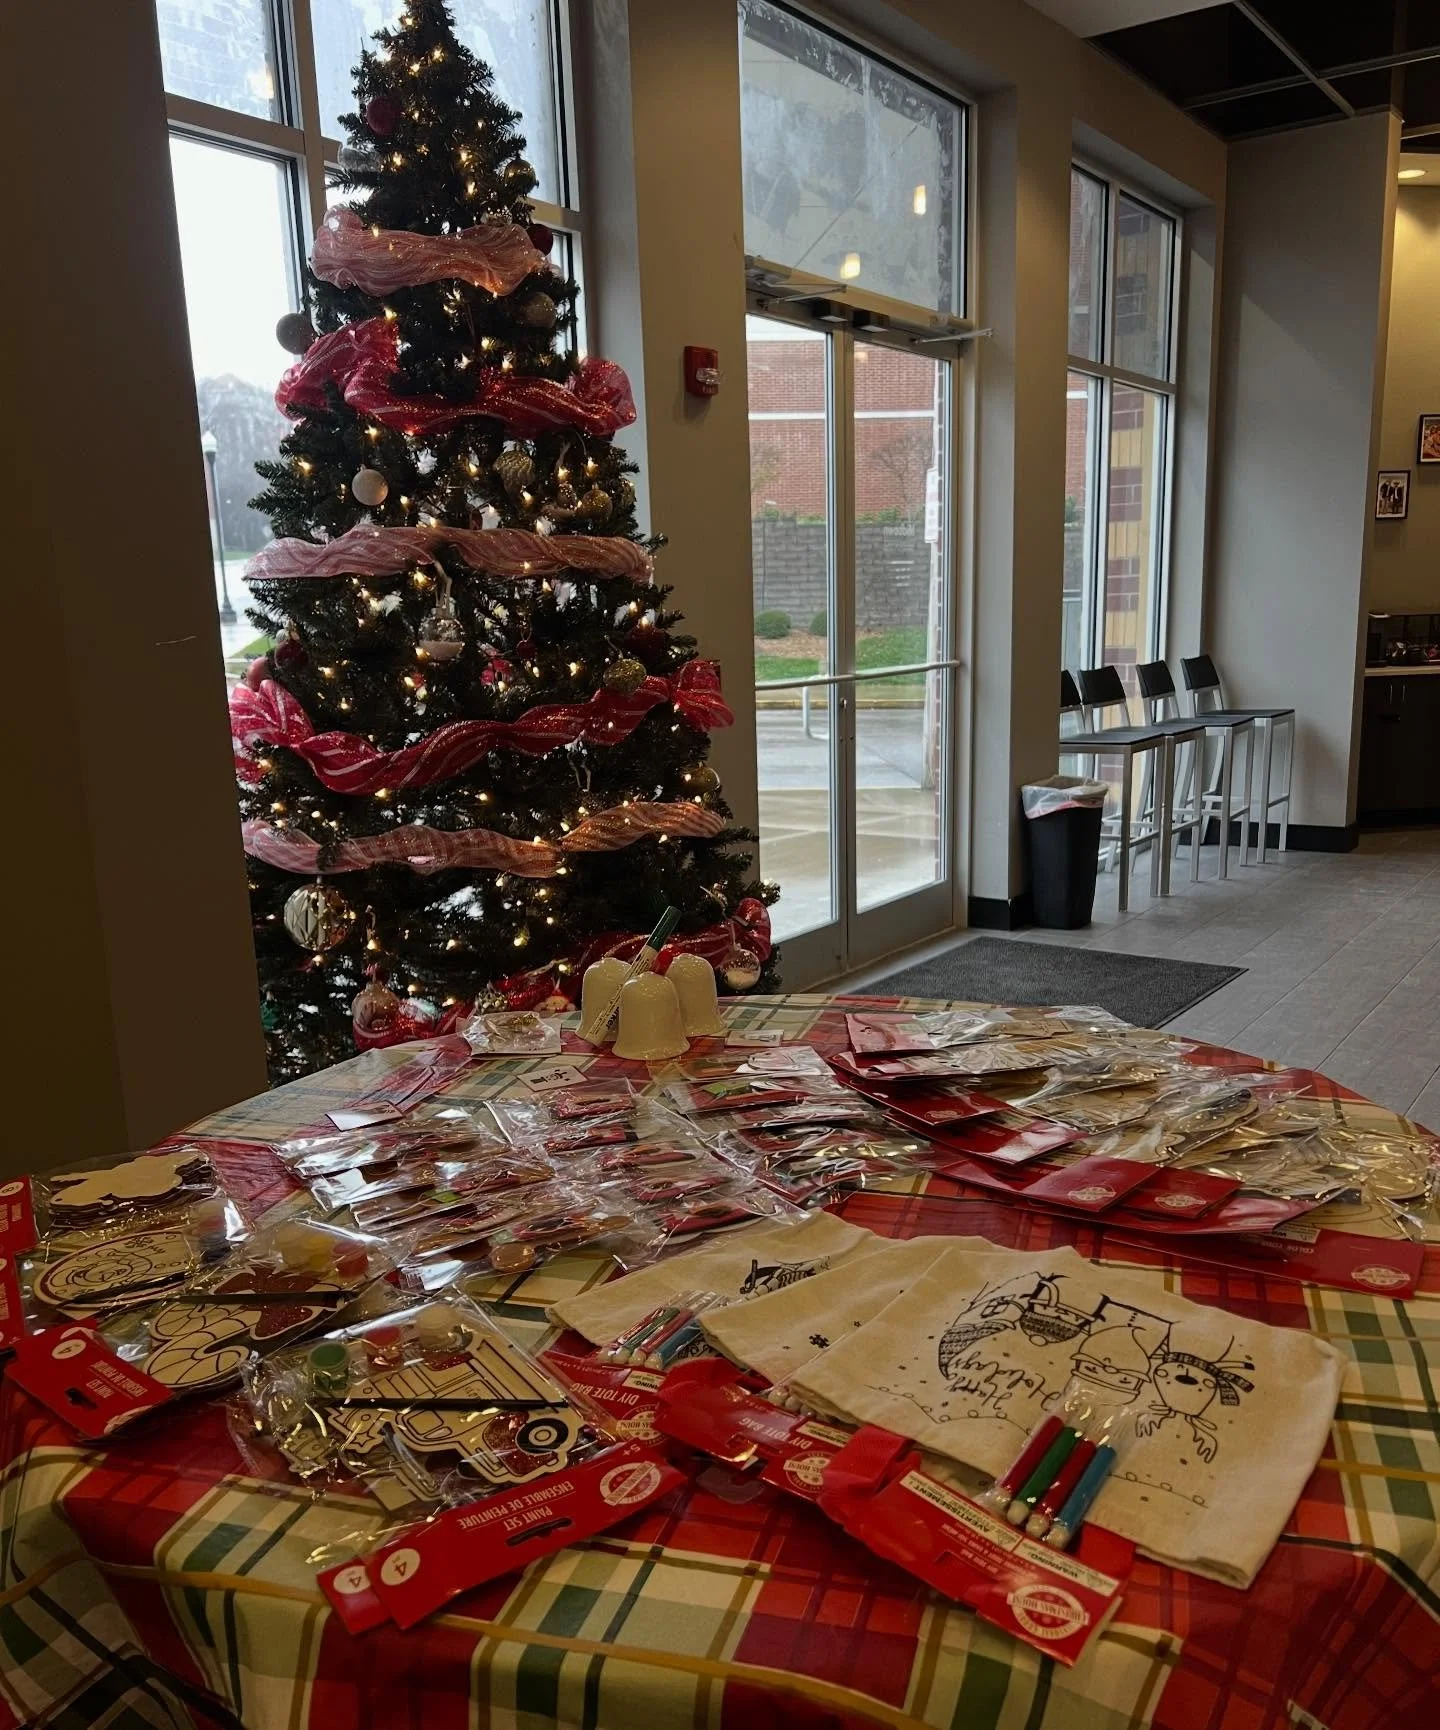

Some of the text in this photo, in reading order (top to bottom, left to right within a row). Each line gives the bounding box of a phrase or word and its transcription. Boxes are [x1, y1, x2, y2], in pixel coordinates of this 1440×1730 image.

[954, 1351, 1061, 1411] Holidays
[569, 1382, 639, 1405] DIY TOTE BAG
[737, 1416, 765, 1431] BAG
[761, 1425, 790, 1441] TOTE
[622, 1442, 641, 1456] 5+
[787, 1435, 812, 1449] DIY
[456, 1480, 573, 1529] ENSEMBLE DE PEINTURE
[502, 1505, 552, 1531] PAINT SET
[394, 1561, 406, 1576] 4
[349, 1576, 360, 1588] 4
